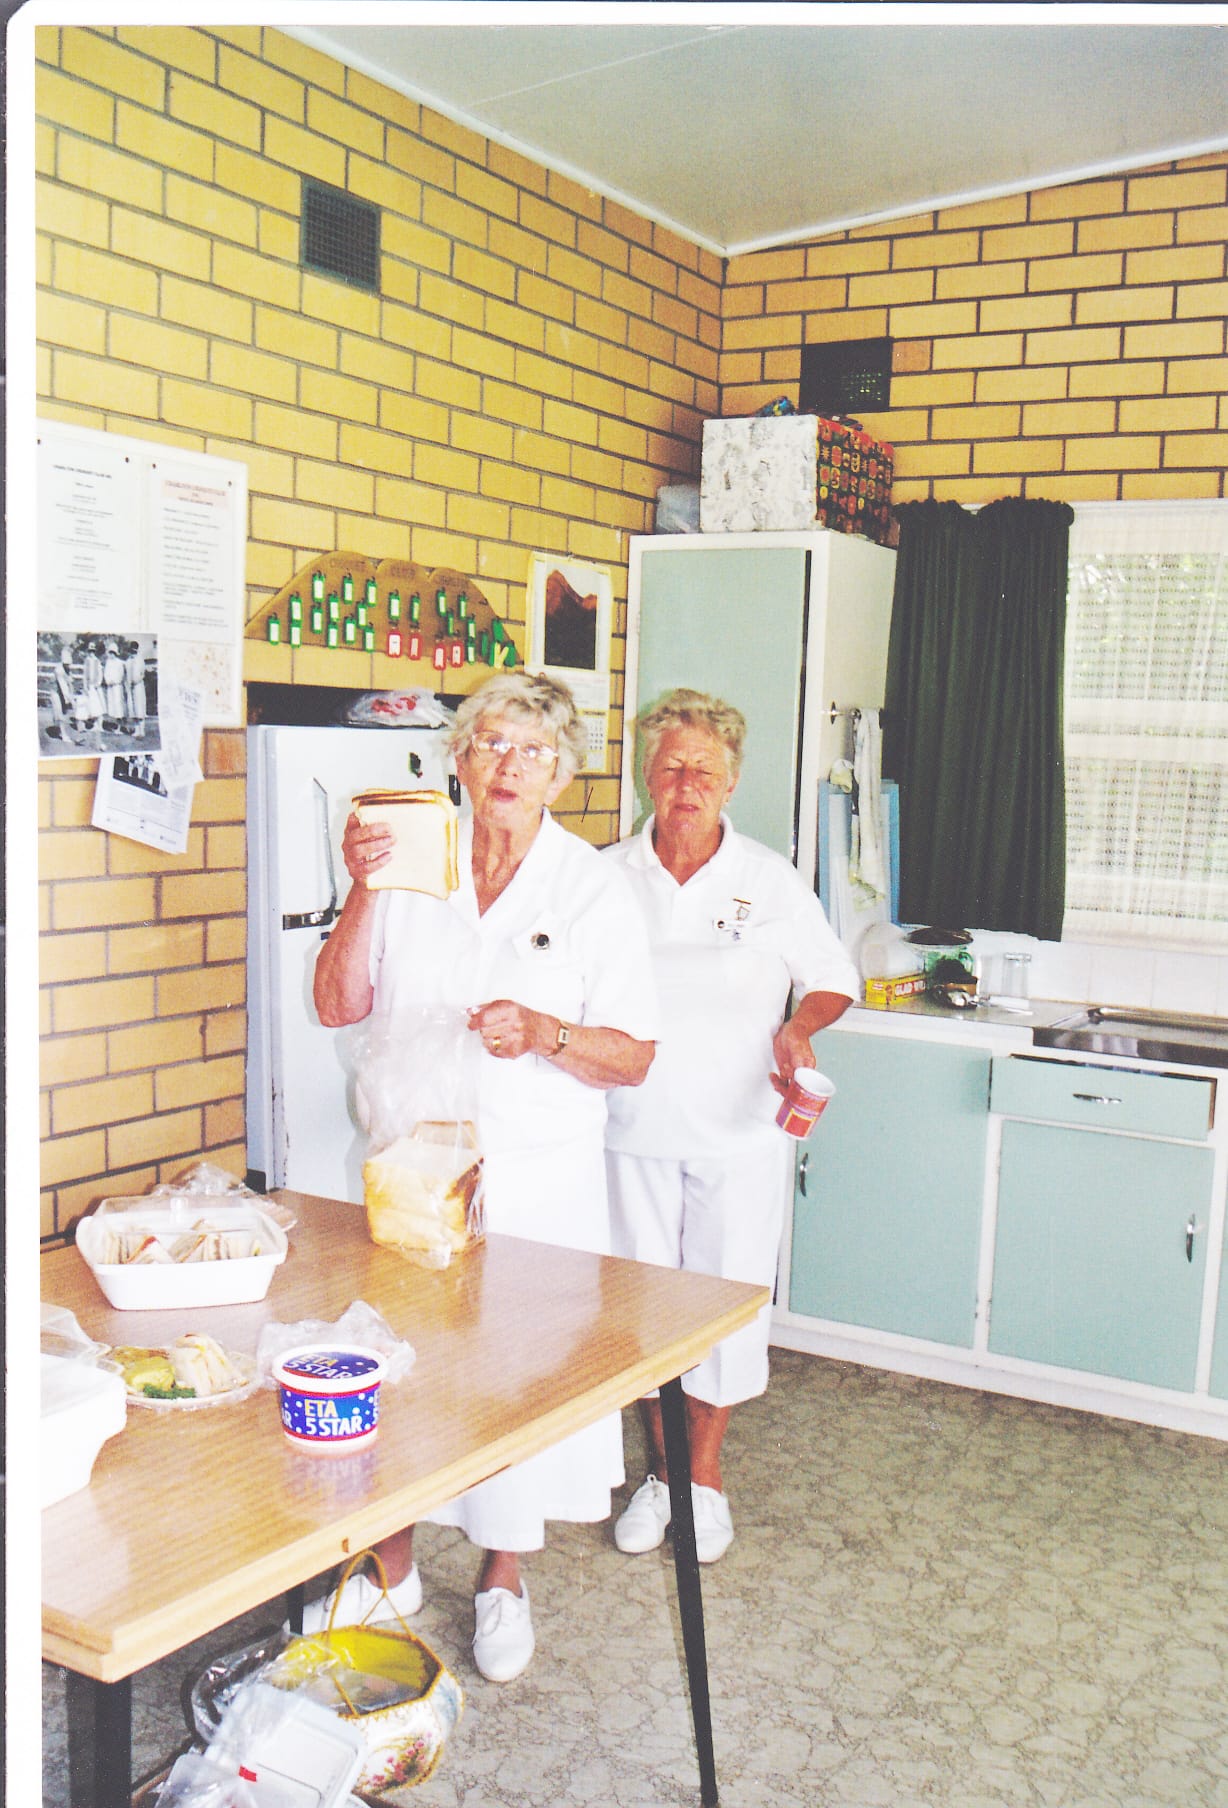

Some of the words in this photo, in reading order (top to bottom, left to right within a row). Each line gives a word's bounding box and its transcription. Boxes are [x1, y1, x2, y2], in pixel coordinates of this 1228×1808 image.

[304, 1399, 339, 1418] ETA
[305, 1417, 318, 1435] 5
[318, 1415, 363, 1437] STAR
